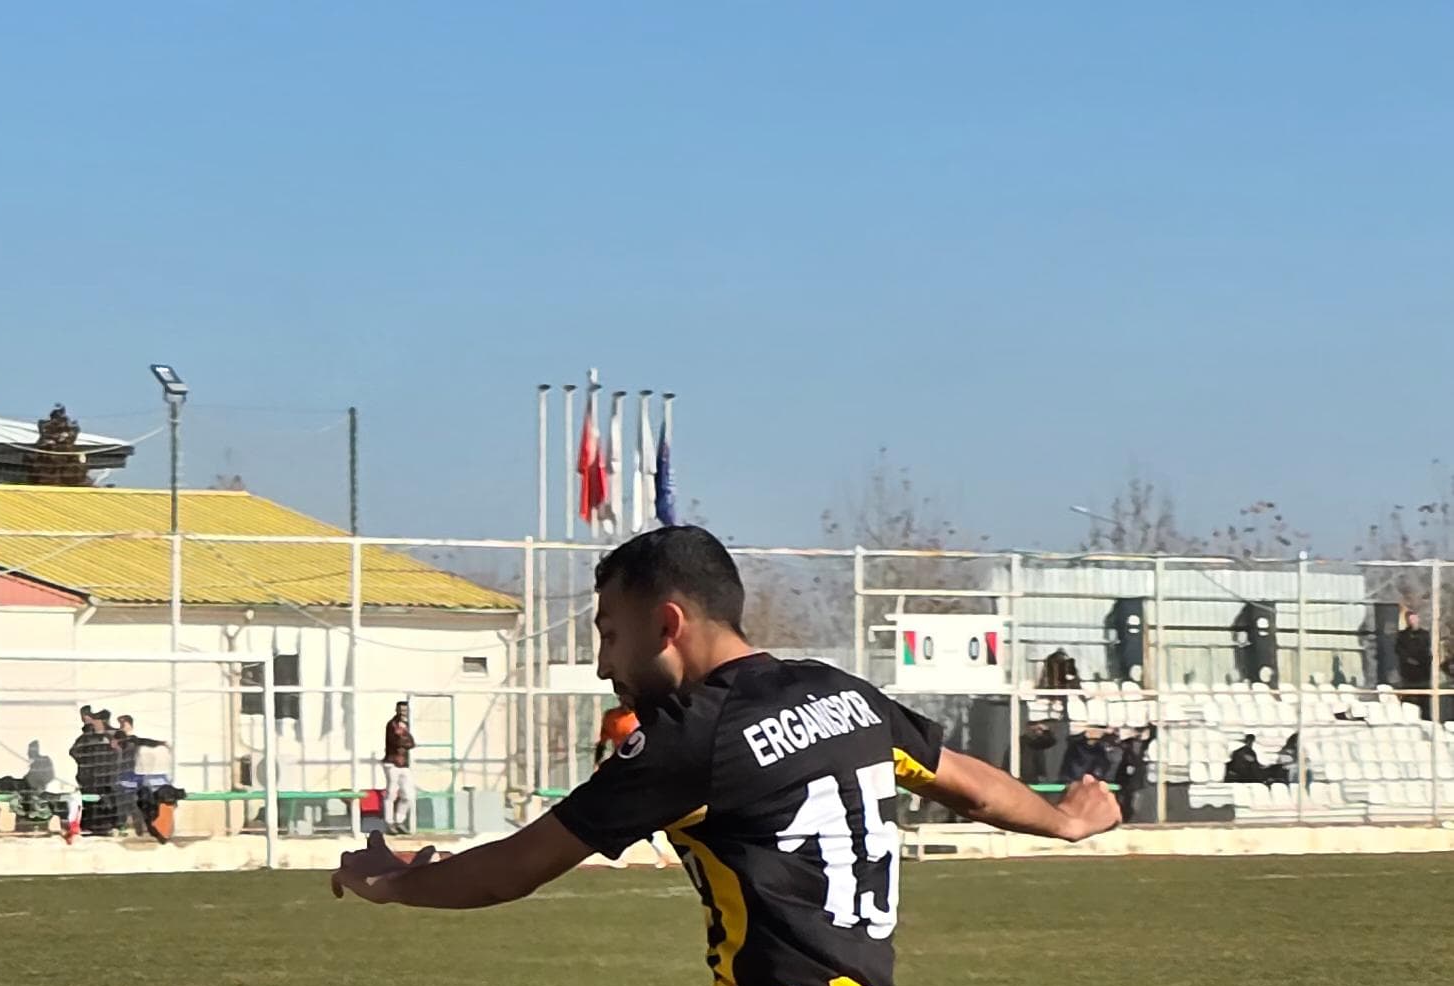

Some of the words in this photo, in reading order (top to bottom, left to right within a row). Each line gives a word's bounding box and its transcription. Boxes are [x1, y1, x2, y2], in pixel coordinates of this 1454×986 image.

[968, 637, 980, 660] 0
[743, 690, 882, 767] ERGANİSPOR
[775, 761, 900, 940] 15
